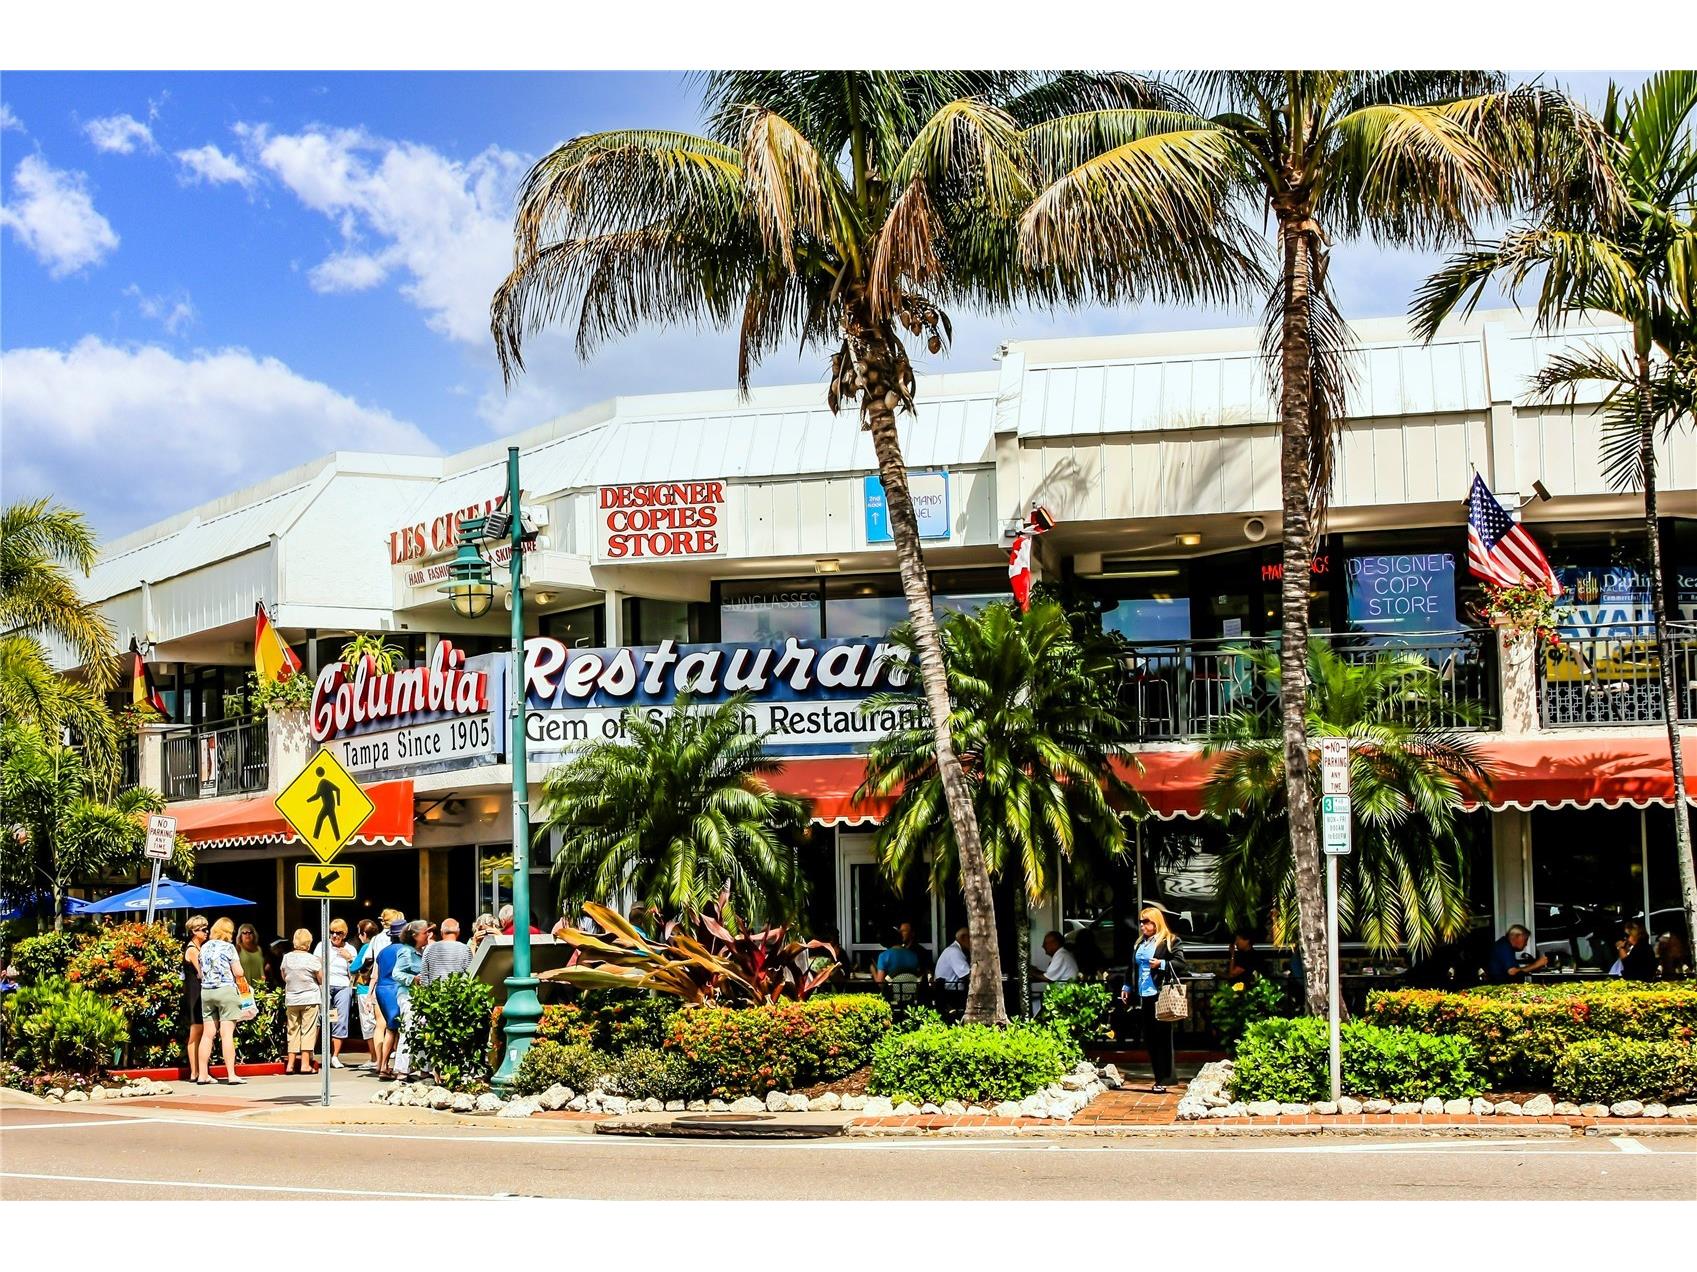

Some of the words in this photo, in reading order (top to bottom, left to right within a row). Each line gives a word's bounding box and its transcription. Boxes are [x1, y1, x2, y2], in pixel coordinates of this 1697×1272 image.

[600, 482, 725, 509] DESIGNER
[606, 505, 718, 533] COPIES
[390, 522, 426, 565] LES
[607, 530, 719, 558] STORE
[408, 571, 426, 586] HAIR
[521, 540, 537, 554] ARE
[1349, 553, 1455, 576] DESIGNER
[1374, 576, 1433, 595] COPY
[722, 592, 819, 612] SUNGLASSES
[1369, 595, 1439, 616] STORE
[523, 637, 912, 698] Restauran
[311, 640, 488, 743] Columbia
[525, 712, 588, 741] Gem
[602, 709, 630, 739] of
[343, 740, 389, 769] Tampa
[398, 731, 441, 758] Since
[450, 718, 490, 751] 1905
[1330, 742, 1340, 753] NO
[1324, 757, 1347, 767] PARKING
[1330, 782, 1342, 791] TIME
[1325, 798, 1333, 812] 3
[150, 828, 173, 838] PARKING
[158, 820, 168, 828] NO
